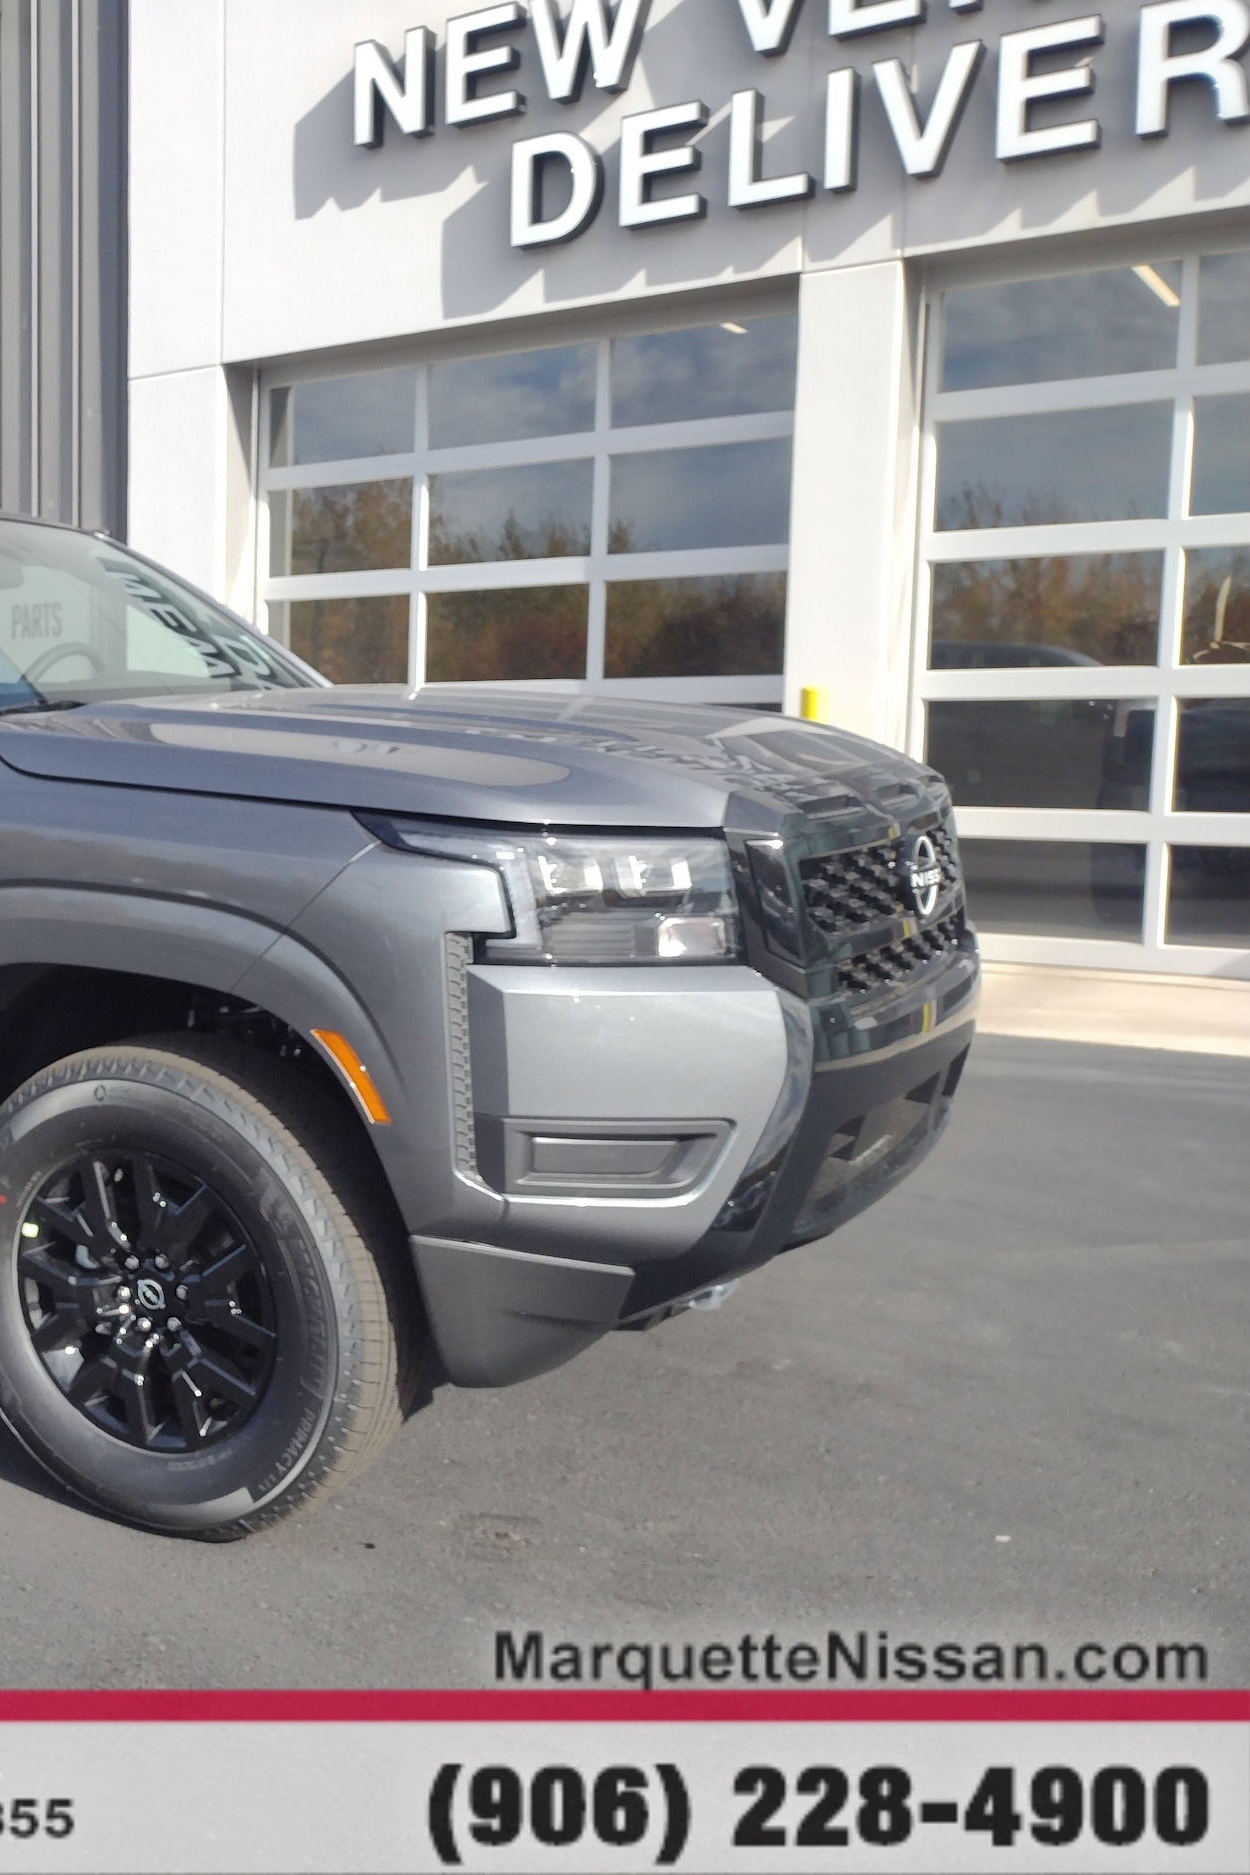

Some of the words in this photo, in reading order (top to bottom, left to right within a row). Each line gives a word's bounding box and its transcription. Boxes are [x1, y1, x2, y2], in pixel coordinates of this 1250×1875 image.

[353, 0, 647, 148] NEW
[510, 0, 1250, 249] DELIVER
[11, 602, 62, 640] PARTS
[910, 867, 940, 888] NISS
